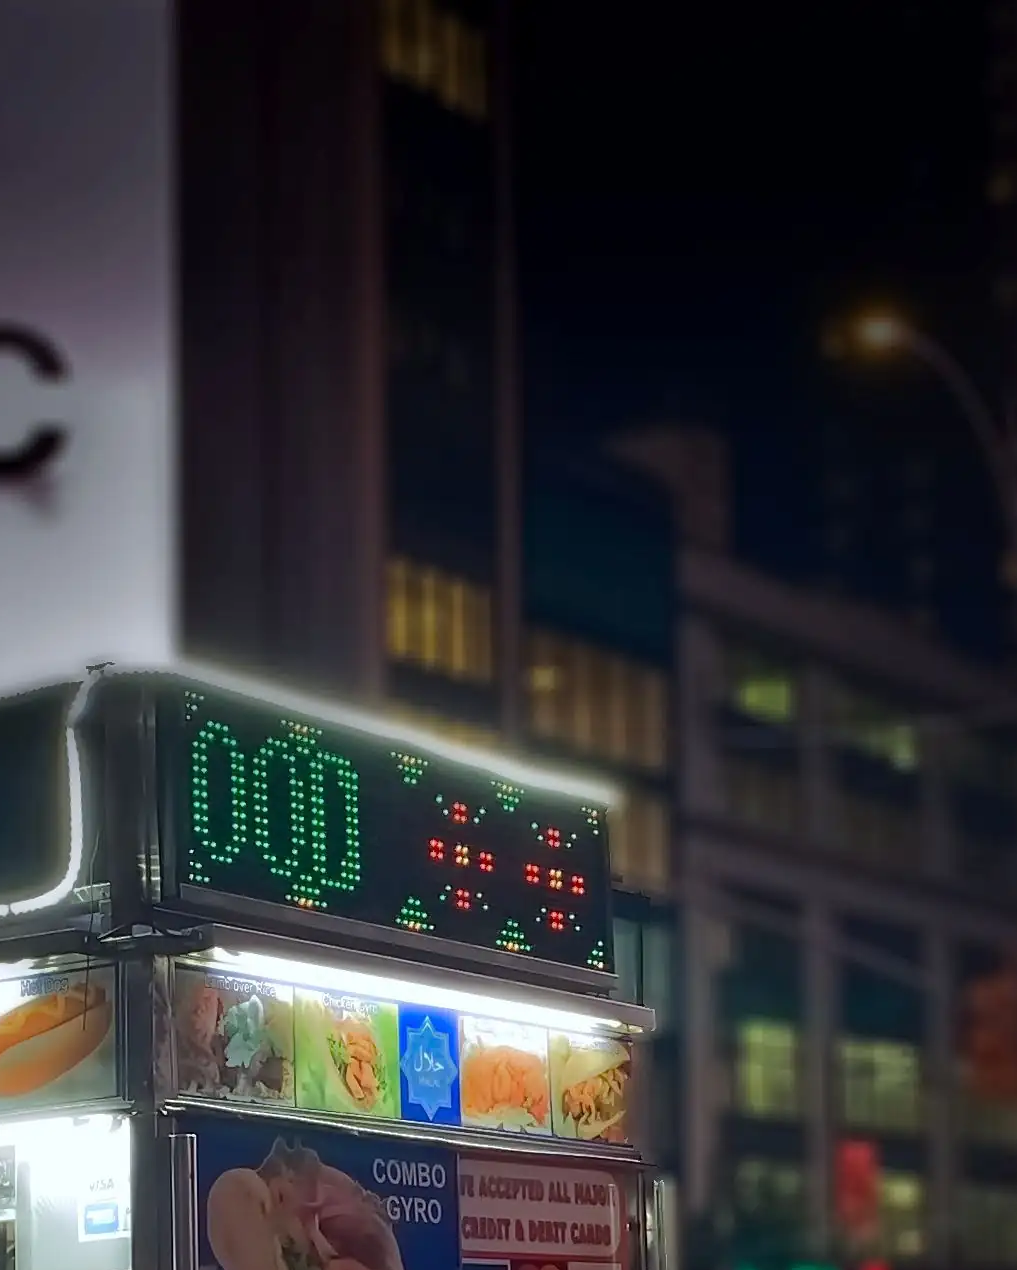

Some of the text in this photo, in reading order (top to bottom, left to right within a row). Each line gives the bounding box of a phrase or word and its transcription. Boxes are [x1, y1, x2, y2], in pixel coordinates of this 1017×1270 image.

[255, 981, 277, 998] Rice
[372, 1158, 446, 1188] COMBO
[478, 1175, 544, 1201] ACCEPTED
[548, 1180, 570, 1200] ALL
[386, 1196, 442, 1224] GYRO
[461, 1215, 611, 1247] CREDIT & DEBIT CARDS
